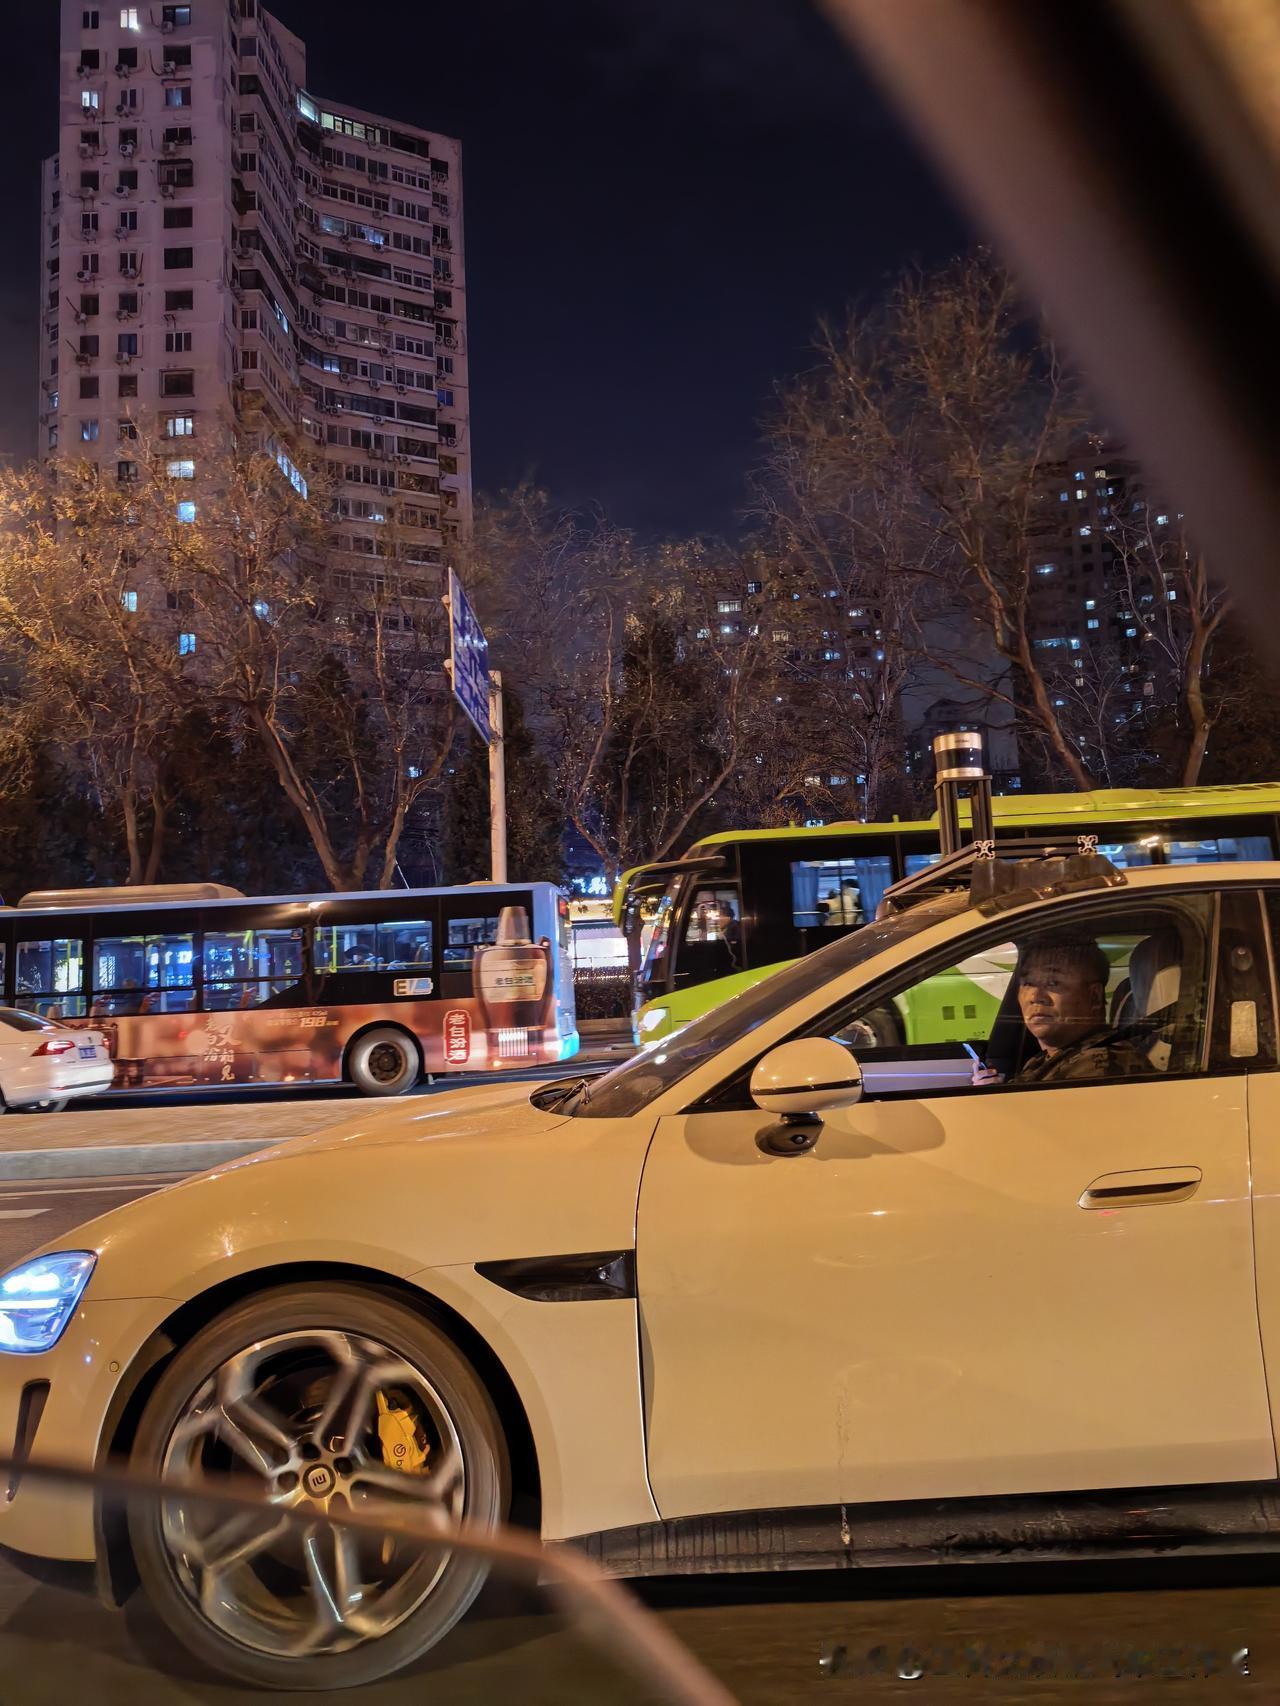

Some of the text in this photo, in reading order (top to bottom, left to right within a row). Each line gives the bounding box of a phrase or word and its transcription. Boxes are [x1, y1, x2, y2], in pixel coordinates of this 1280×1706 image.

[300, 1016, 327, 1028] 198
[448, 1013, 468, 1062] 老白汾酒
